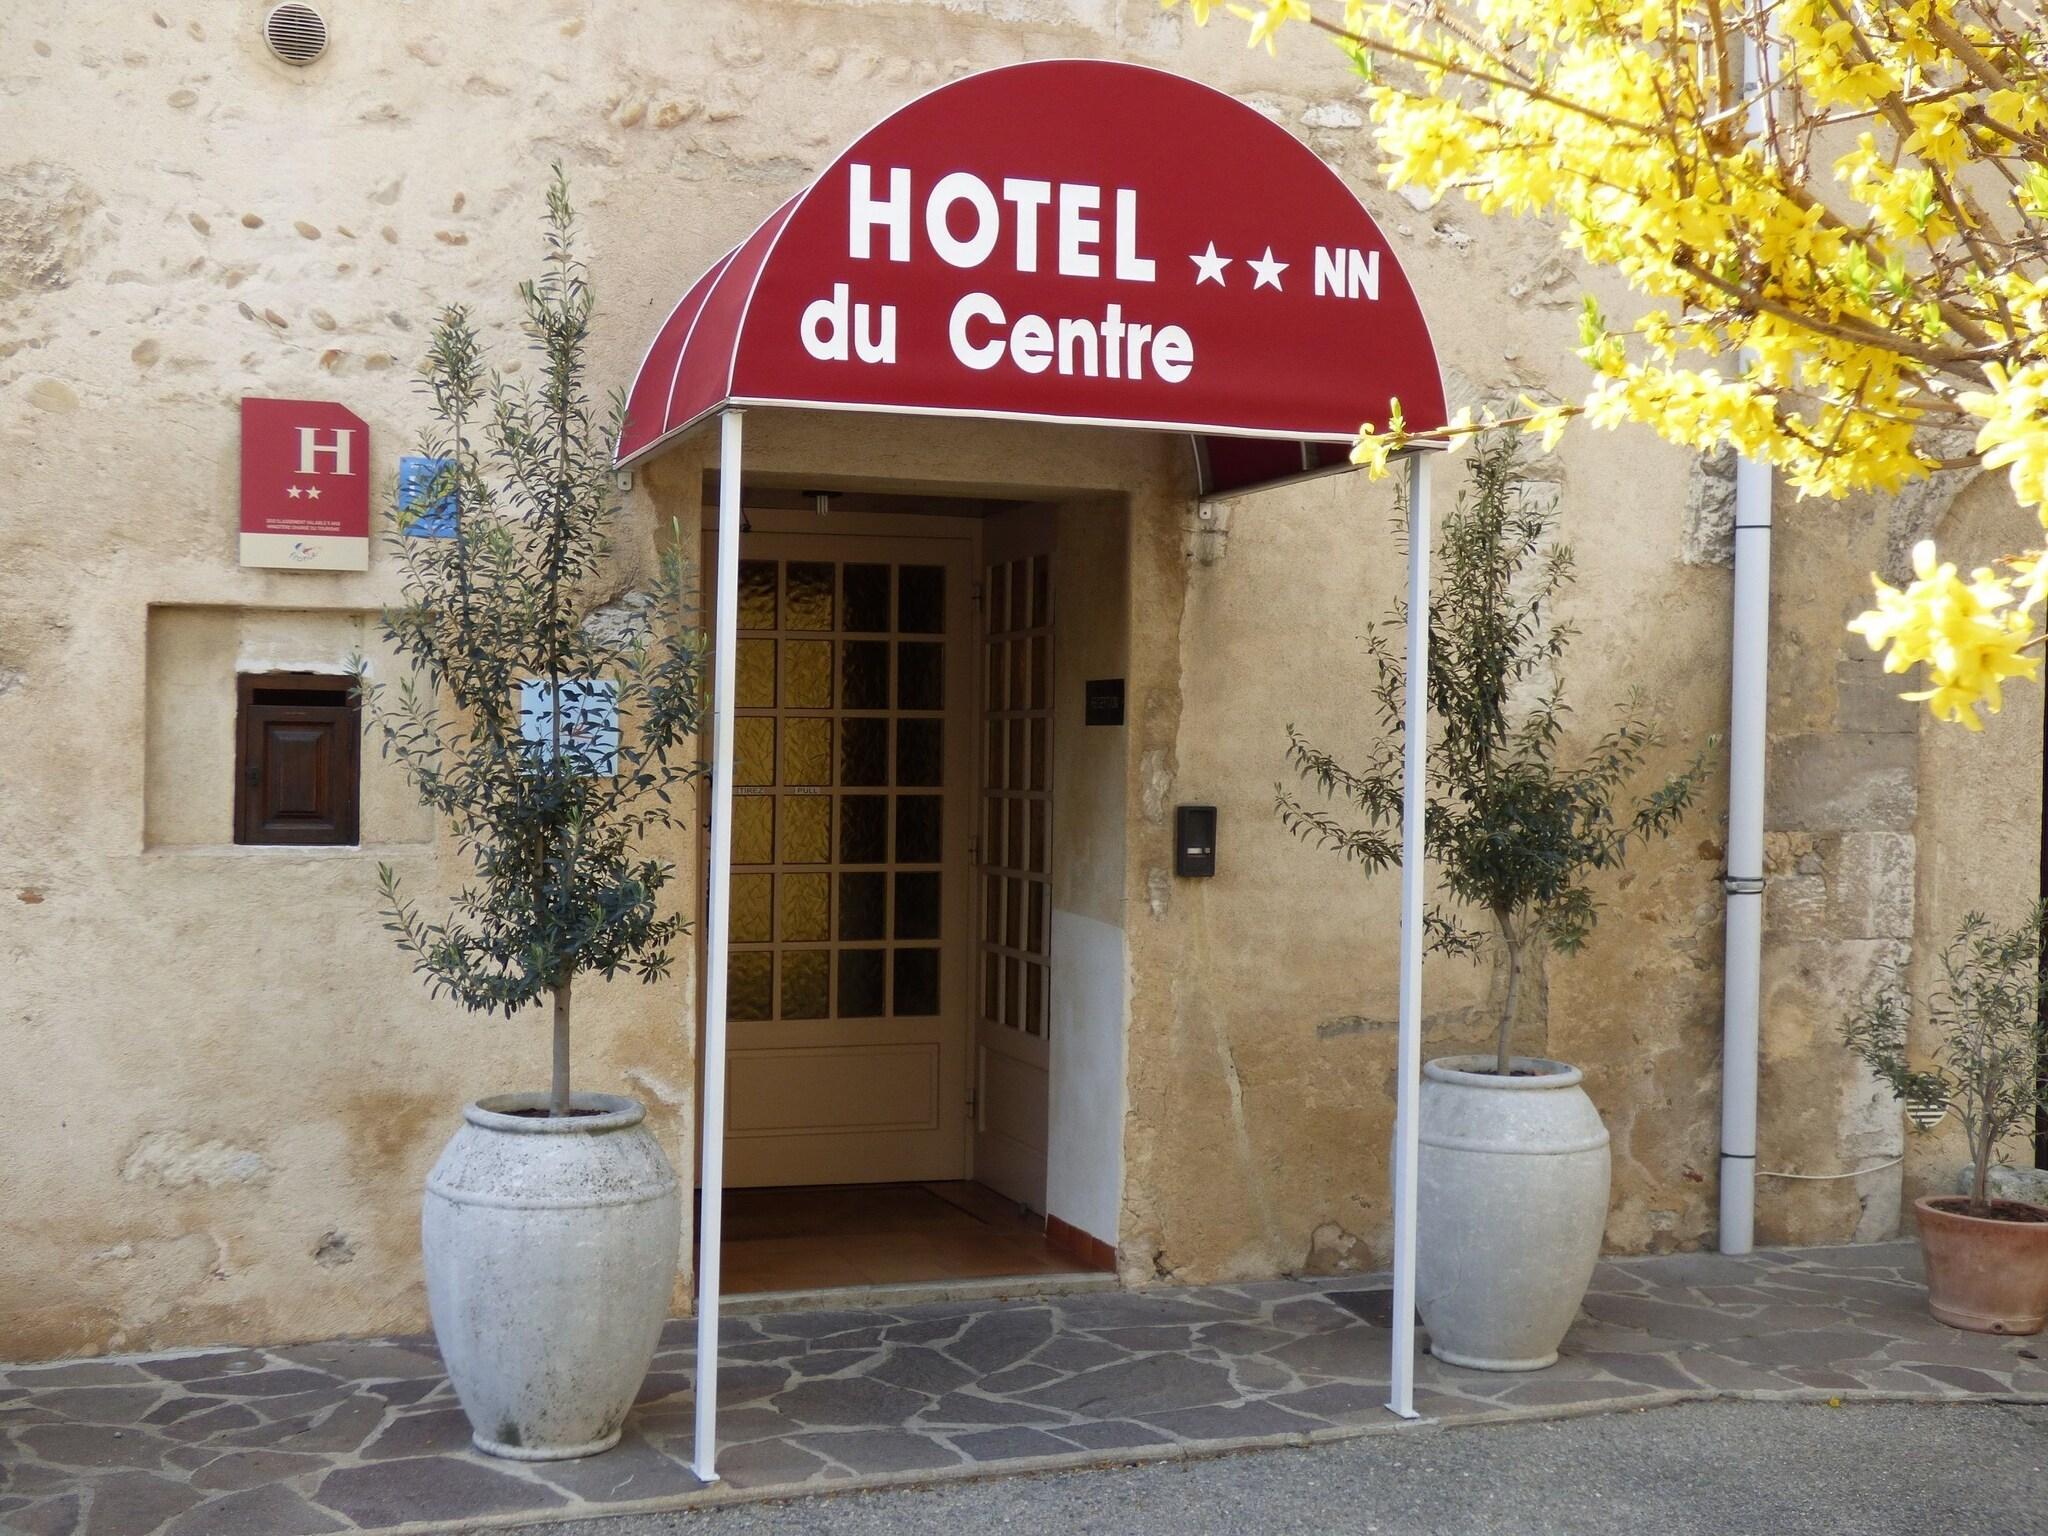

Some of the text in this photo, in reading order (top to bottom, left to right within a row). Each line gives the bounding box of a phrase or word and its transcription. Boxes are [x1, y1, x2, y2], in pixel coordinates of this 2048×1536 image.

[848, 163, 1380, 301] HOTEL NN
[800, 282, 1194, 384] du Centre
[294, 426, 357, 476] H
